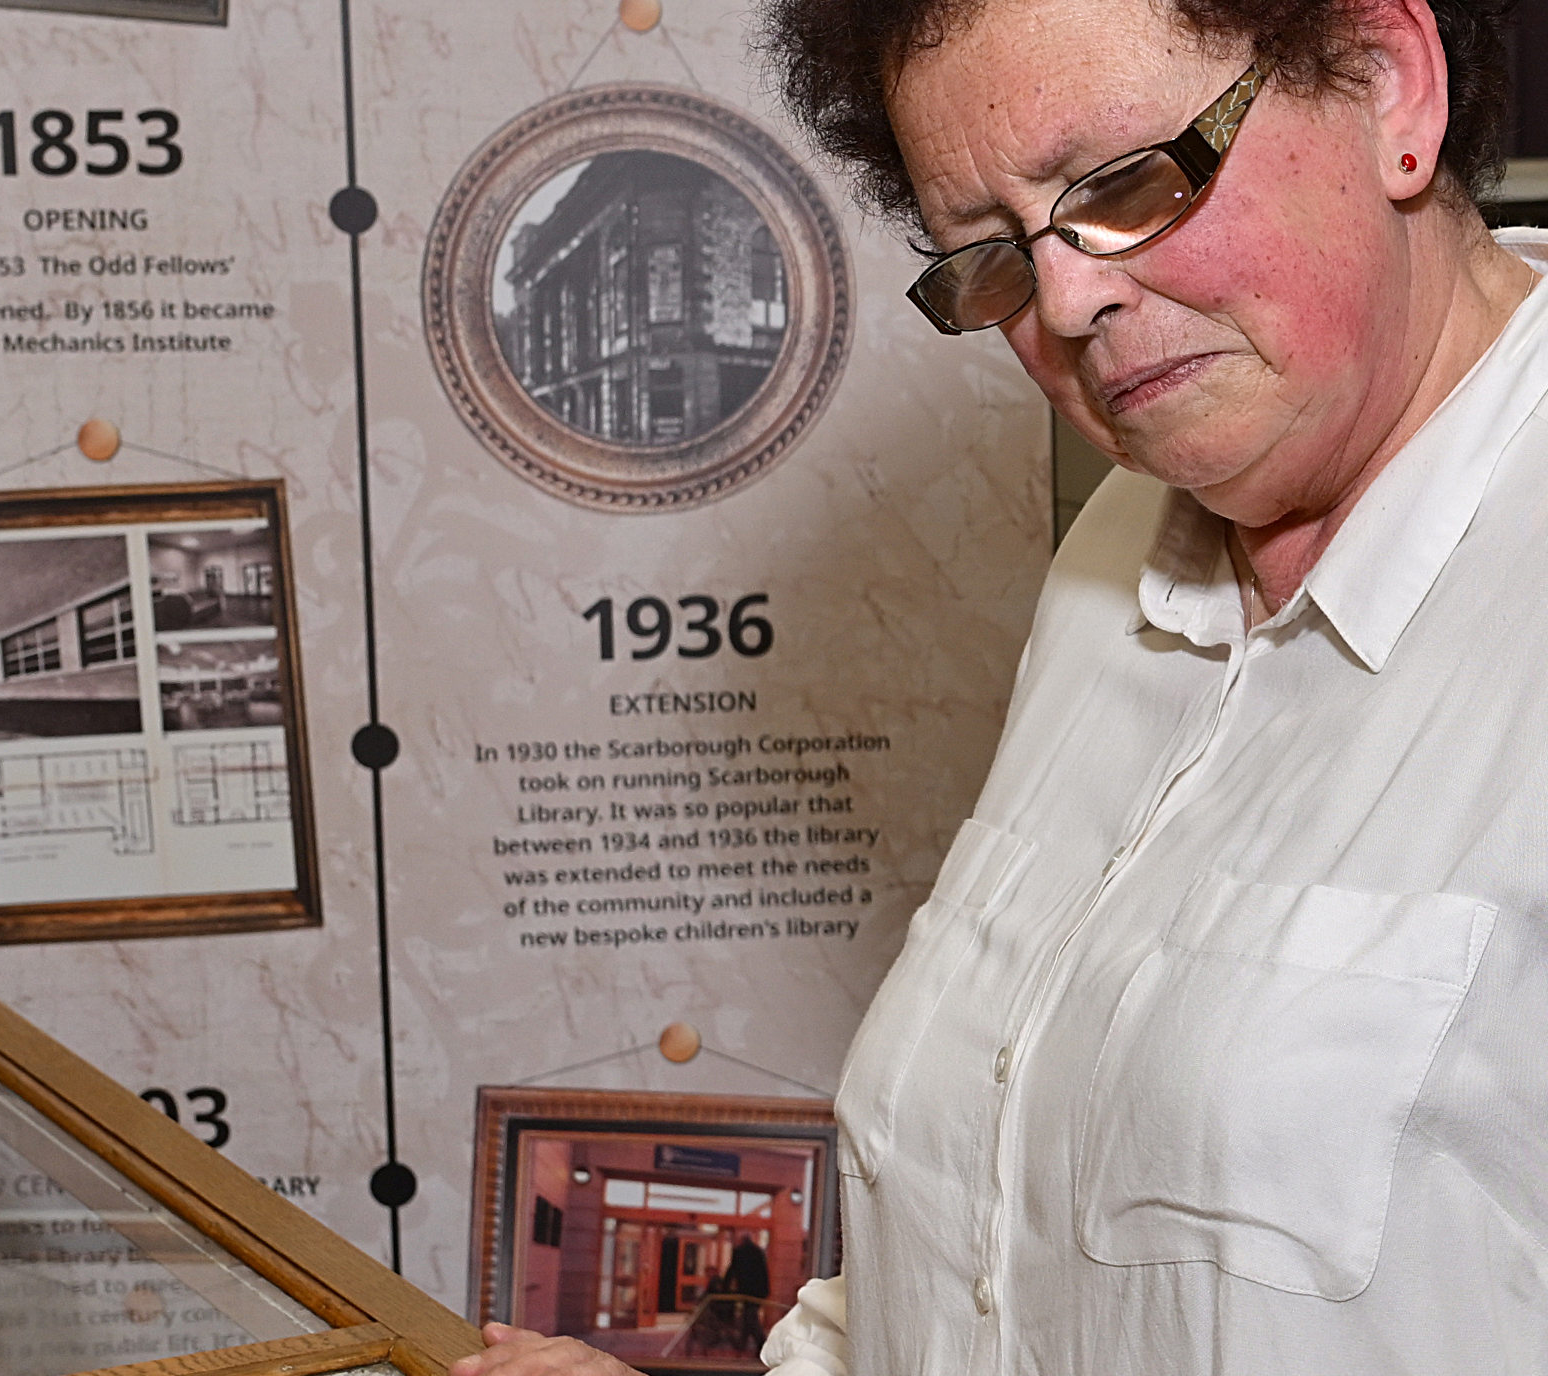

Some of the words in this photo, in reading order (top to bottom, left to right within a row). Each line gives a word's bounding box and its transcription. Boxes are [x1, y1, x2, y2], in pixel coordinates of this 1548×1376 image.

[22, 208, 149, 232] OPENING
[37, 256, 82, 276] The
[88, 255, 137, 276] Odd
[64, 301, 94, 325] By
[102, 300, 154, 321] 1856
[160, 300, 176, 320] it
[183, 299, 276, 320] became
[3, 333, 125, 354] Mechanics
[132, 332, 232, 352] Institute
[582, 593, 775, 662] 1936
[609, 690, 758, 717] EXTENSION
[474, 743, 498, 763] In
[505, 742, 558, 762] 1930
[564, 741, 601, 760] the
[608, 736, 752, 759] Scarborough
[758, 732, 891, 758] Corporation
[519, 773, 570, 793] took
[577, 776, 606, 791] on
[612, 771, 701, 794] running
[707, 765, 850, 791] Scarborough
[516, 805, 603, 828] Library.
[610, 803, 629, 822] It
[633, 804, 677, 820] was
[684, 802, 709, 819] so
[715, 798, 799, 823] popular
[807, 795, 853, 814] that
[493, 835, 593, 857] between
[600, 833, 651, 853] 1934
[658, 831, 700, 850] and
[707, 829, 758, 848] 1936
[764, 827, 801, 847] the
[807, 825, 880, 850] library
[504, 869, 548, 887] was
[555, 862, 661, 886] extended
[668, 862, 691, 881] to
[697, 861, 753, 879] meet
[761, 857, 798, 877] the
[804, 855, 871, 876] needs
[504, 897, 527, 918] of
[533, 896, 570, 916] the
[577, 892, 704, 915] community
[711, 888, 752, 909] and
[758, 885, 853, 907] included
[860, 888, 873, 904] a
[520, 929, 567, 947] new
[574, 924, 669, 949] bespoke
[674, 919, 780, 942] children's
[786, 917, 859, 942] library
